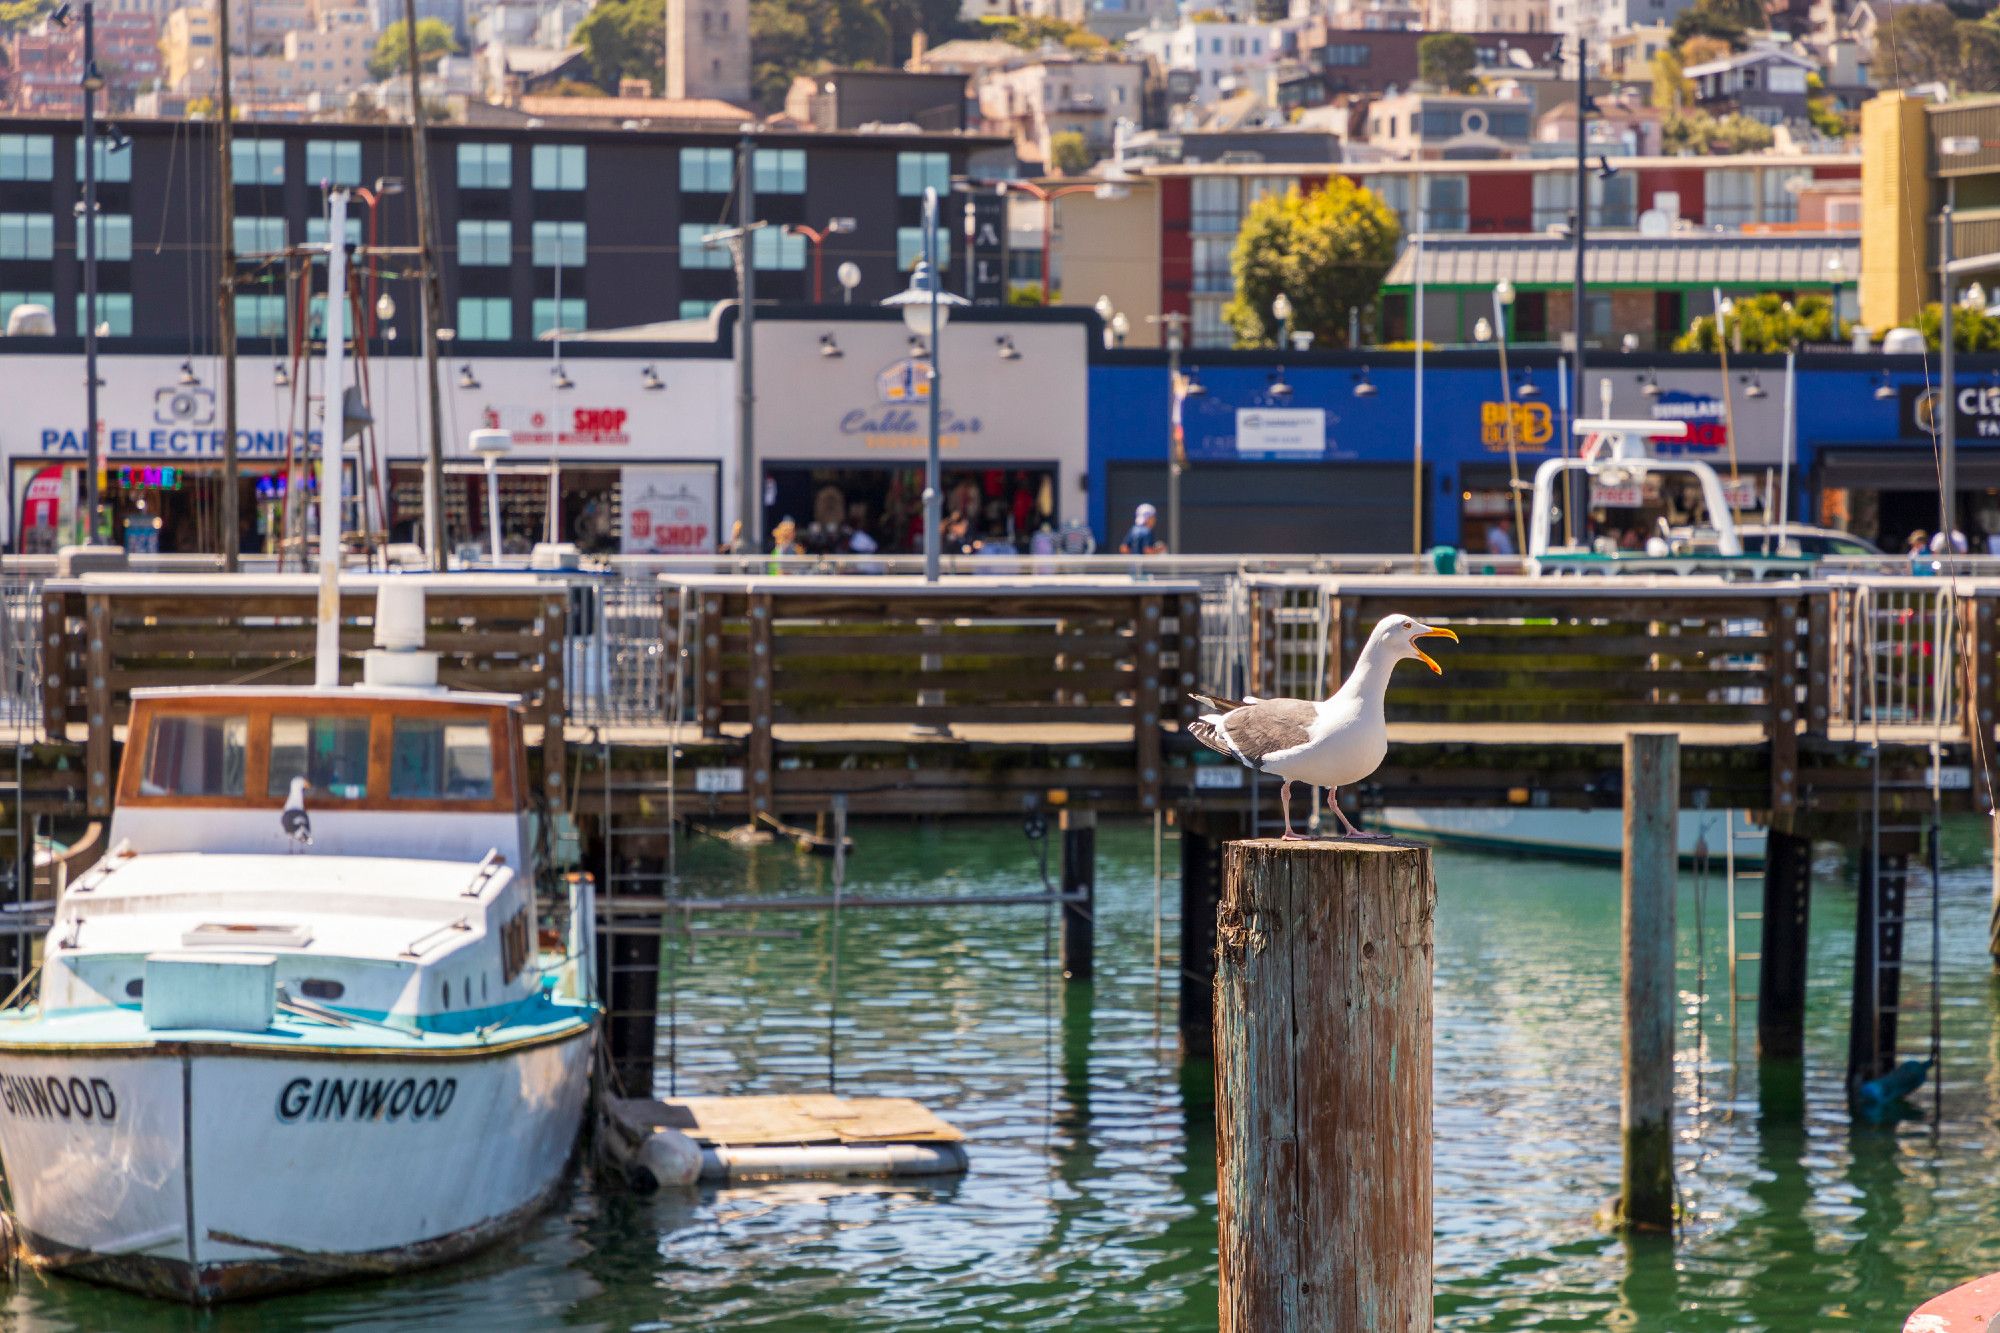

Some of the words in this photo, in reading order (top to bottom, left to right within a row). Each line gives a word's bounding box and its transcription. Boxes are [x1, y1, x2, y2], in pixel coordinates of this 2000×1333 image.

[574, 407, 627, 432] SHOP
[840, 408, 919, 434] Cable
[938, 408, 983, 433] Car
[655, 524, 707, 547] SHOP
[0, 1072, 116, 1120] GINWOOD
[278, 1076, 457, 1122] GINWOOD
